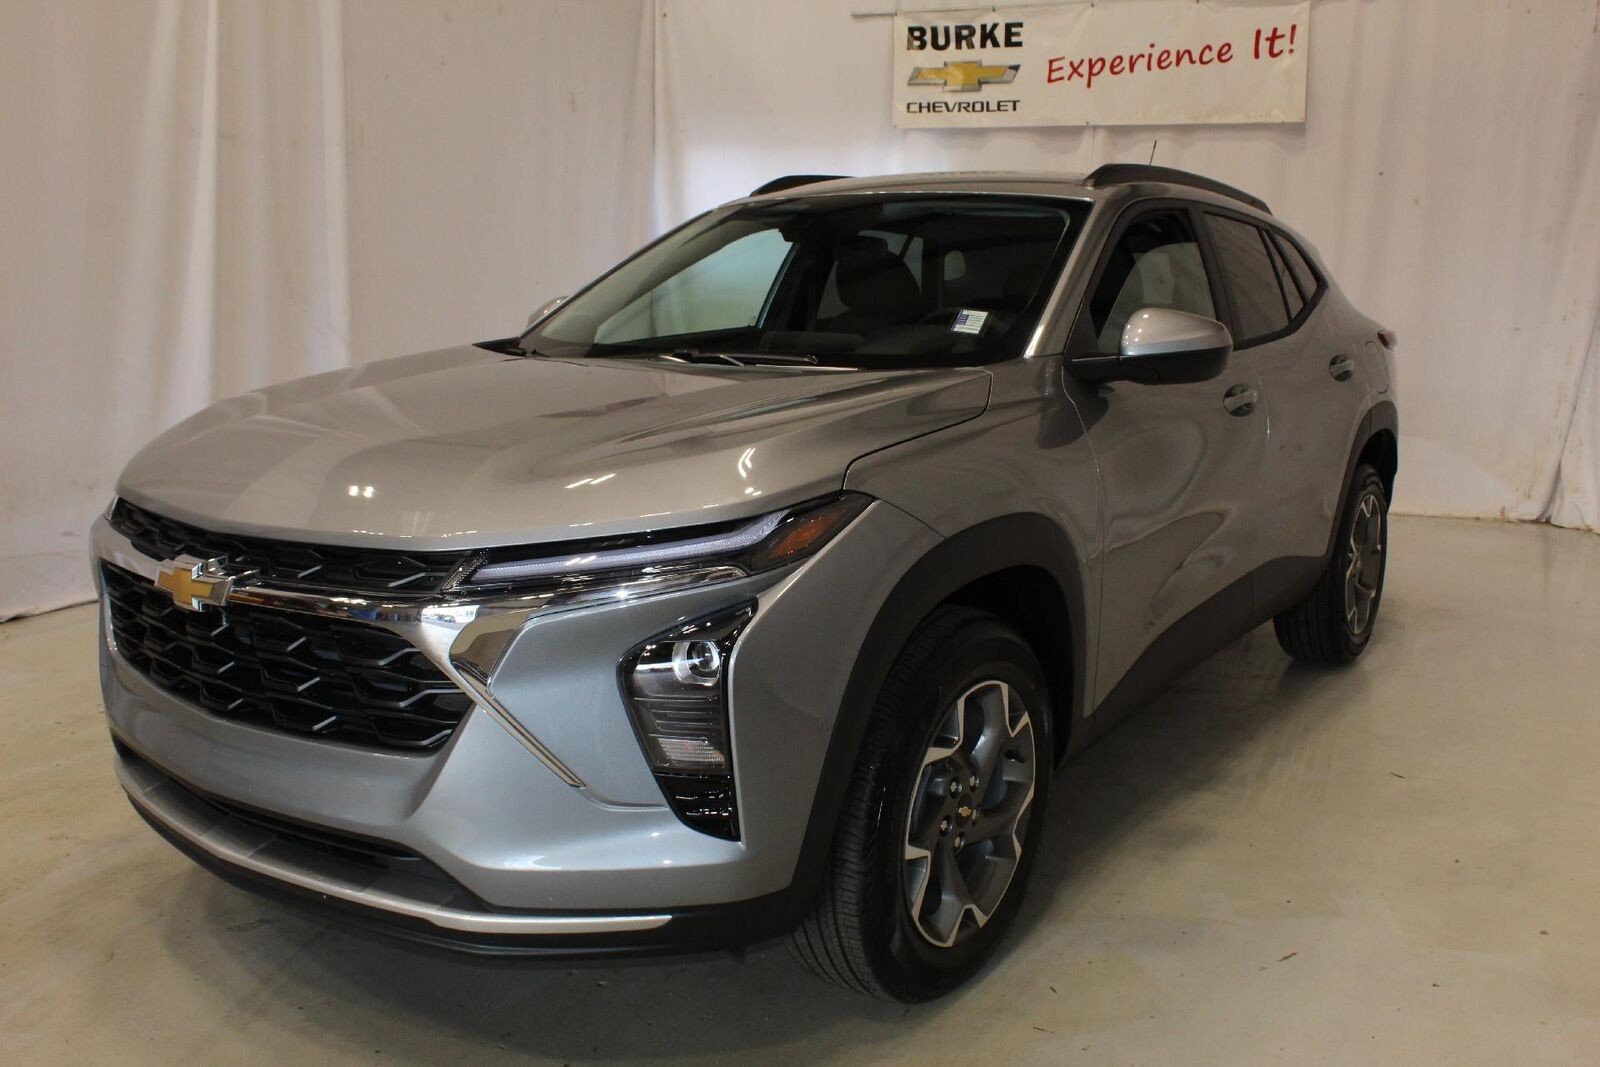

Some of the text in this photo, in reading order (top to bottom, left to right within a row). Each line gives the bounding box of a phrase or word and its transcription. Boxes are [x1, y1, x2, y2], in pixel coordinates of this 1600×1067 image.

[907, 22, 1023, 50] BURKE
[1046, 24, 1298, 88] Experience It!
[906, 99, 1021, 114] CHEVROLET
